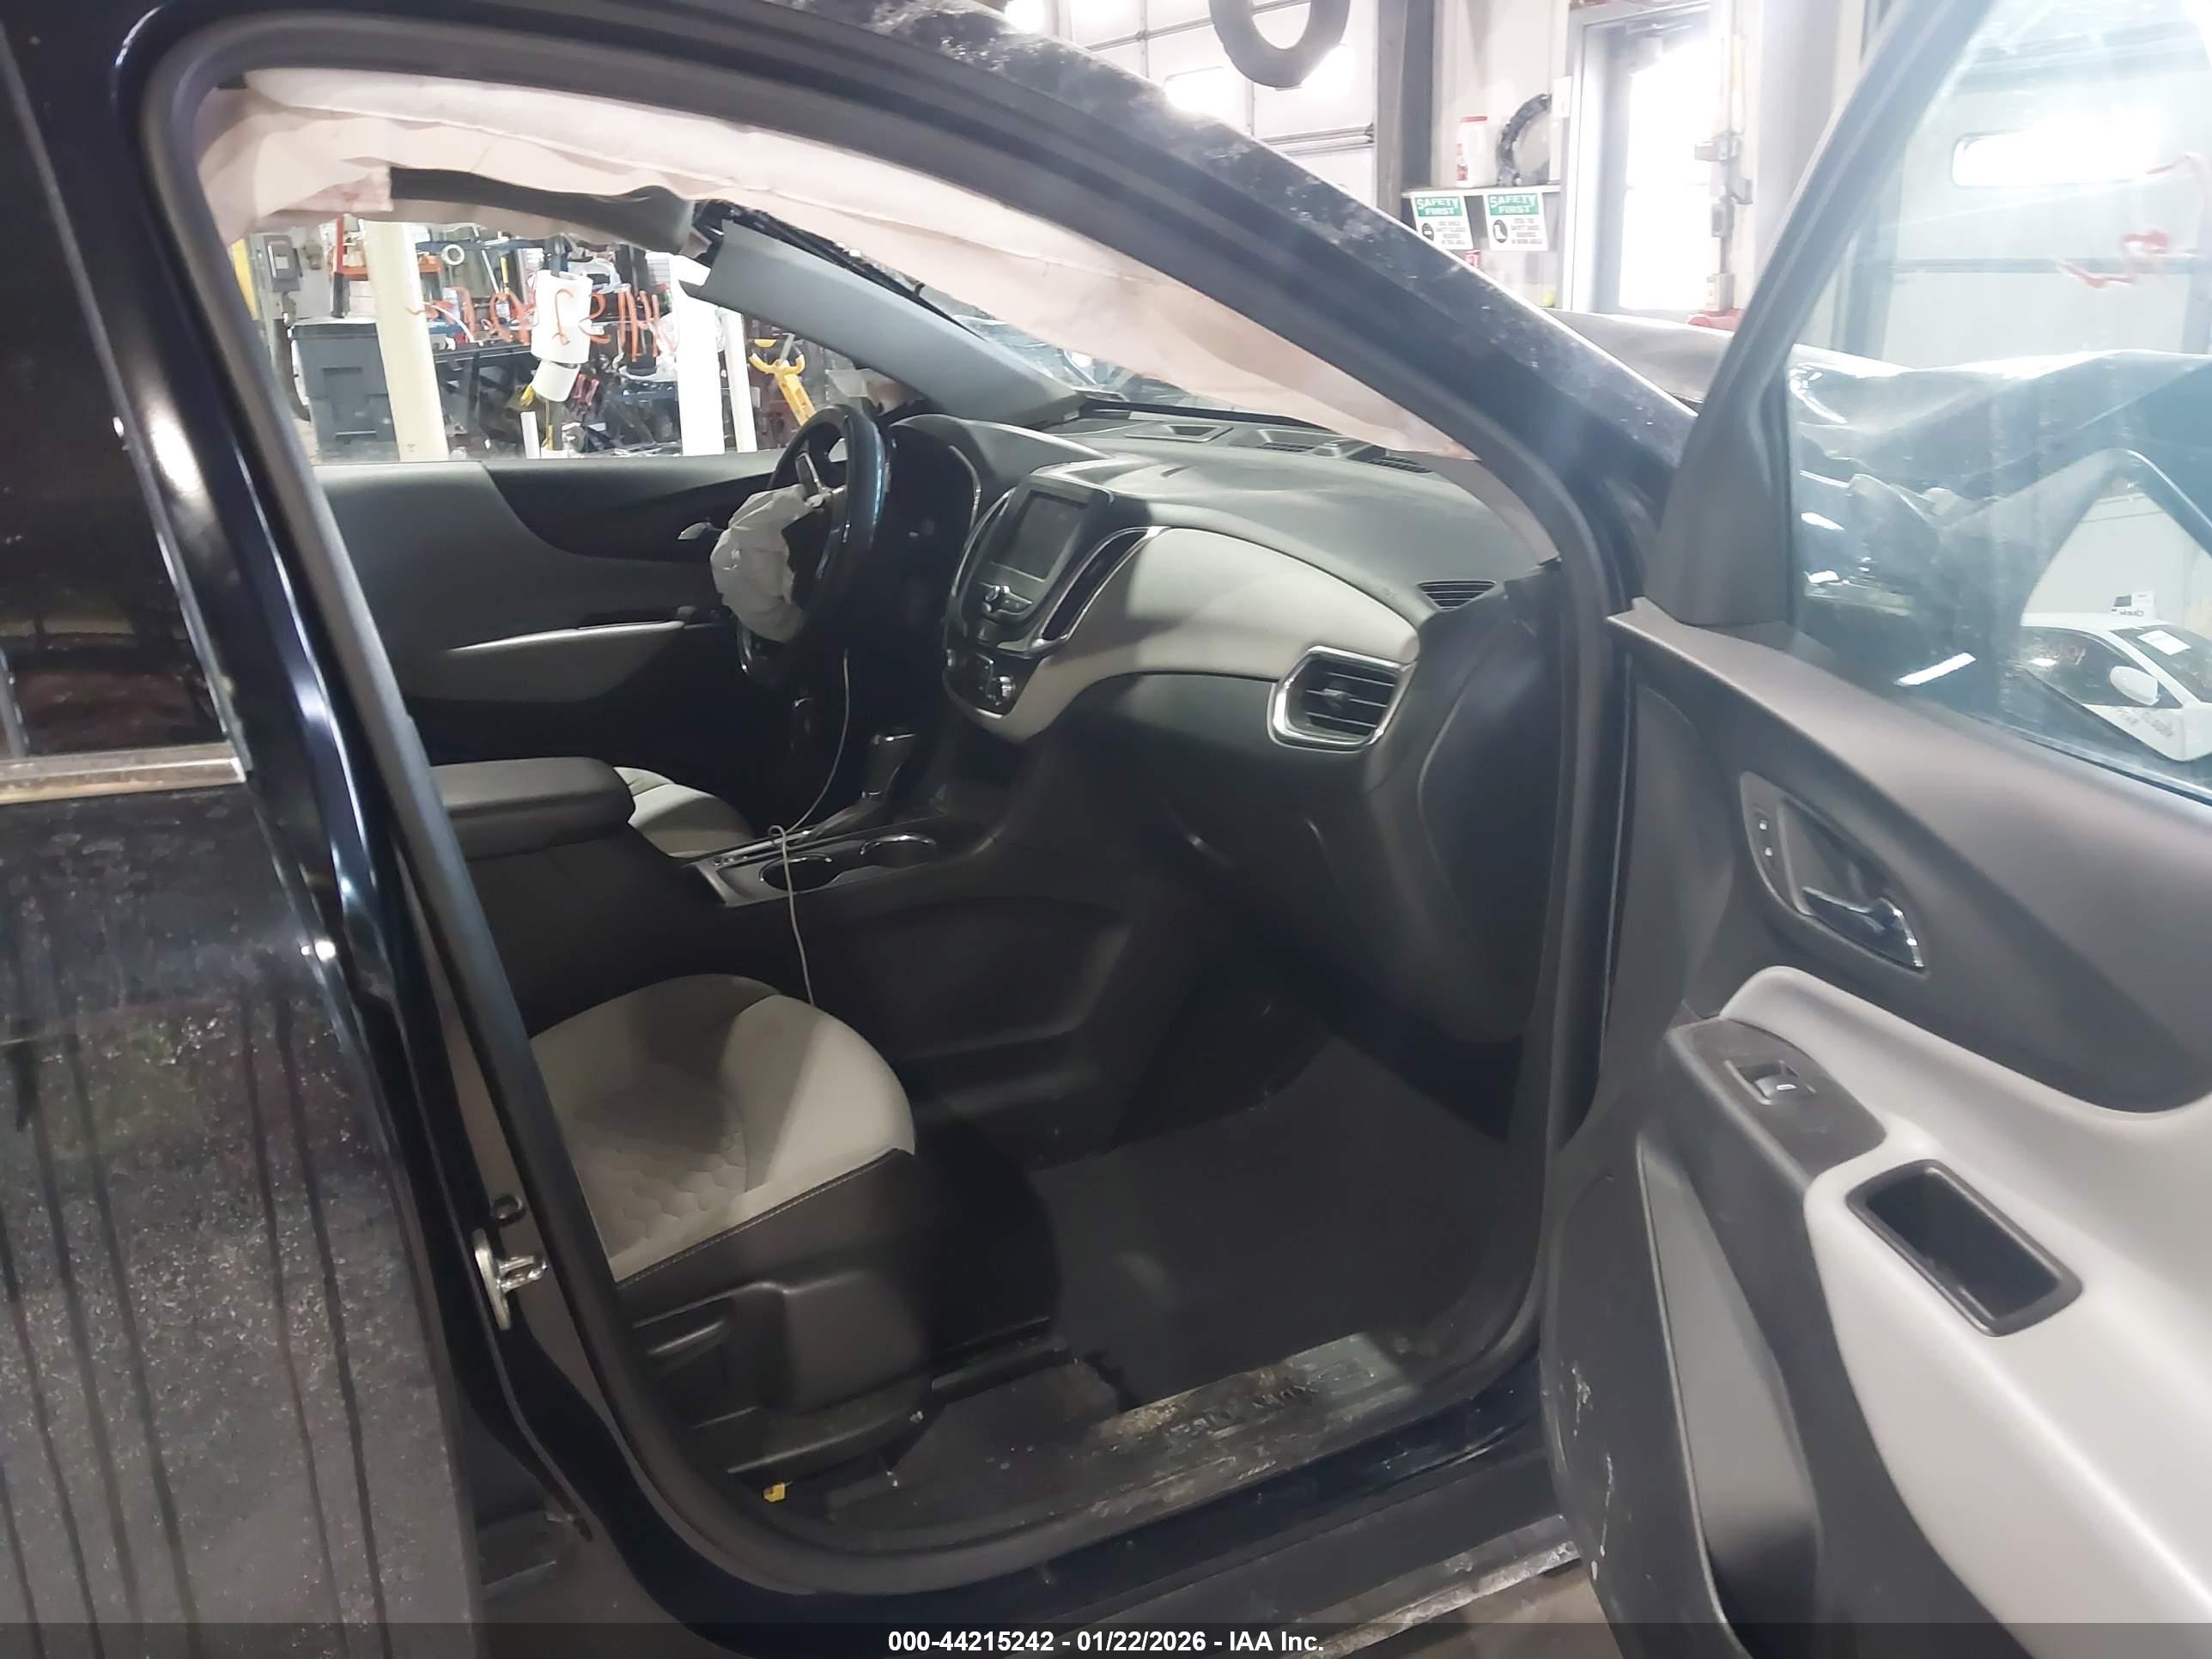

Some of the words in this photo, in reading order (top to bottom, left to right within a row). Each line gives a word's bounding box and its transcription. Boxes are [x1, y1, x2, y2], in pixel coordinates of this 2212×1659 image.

[1416, 198, 1458, 210] SAFETY
[1489, 195, 1535, 208] SAFETY
[1498, 205, 1530, 214] FIRST
